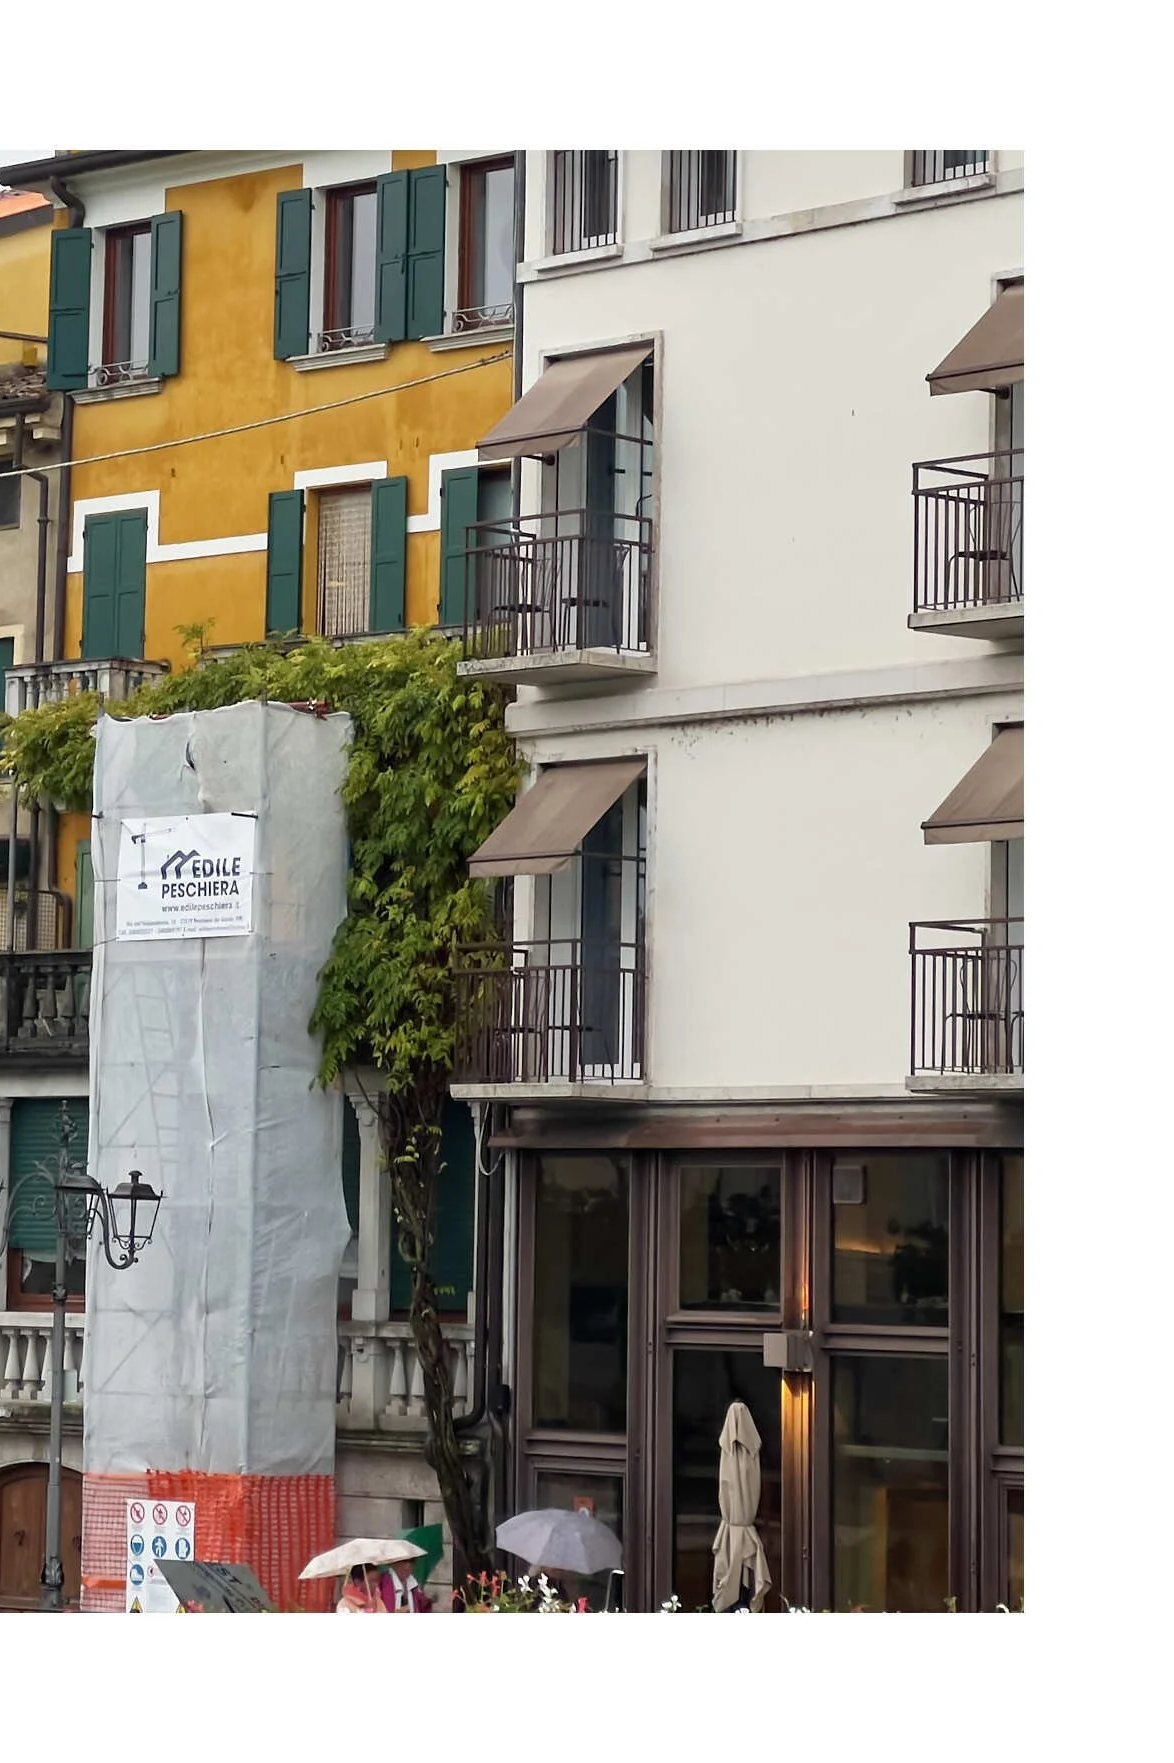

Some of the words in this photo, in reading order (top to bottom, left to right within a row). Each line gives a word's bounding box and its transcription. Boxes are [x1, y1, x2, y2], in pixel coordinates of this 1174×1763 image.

[192, 857, 241, 879] EDILE
[161, 880, 239, 899] PESCHIERA
[161, 901, 241, 913] www.edilepeschierat
